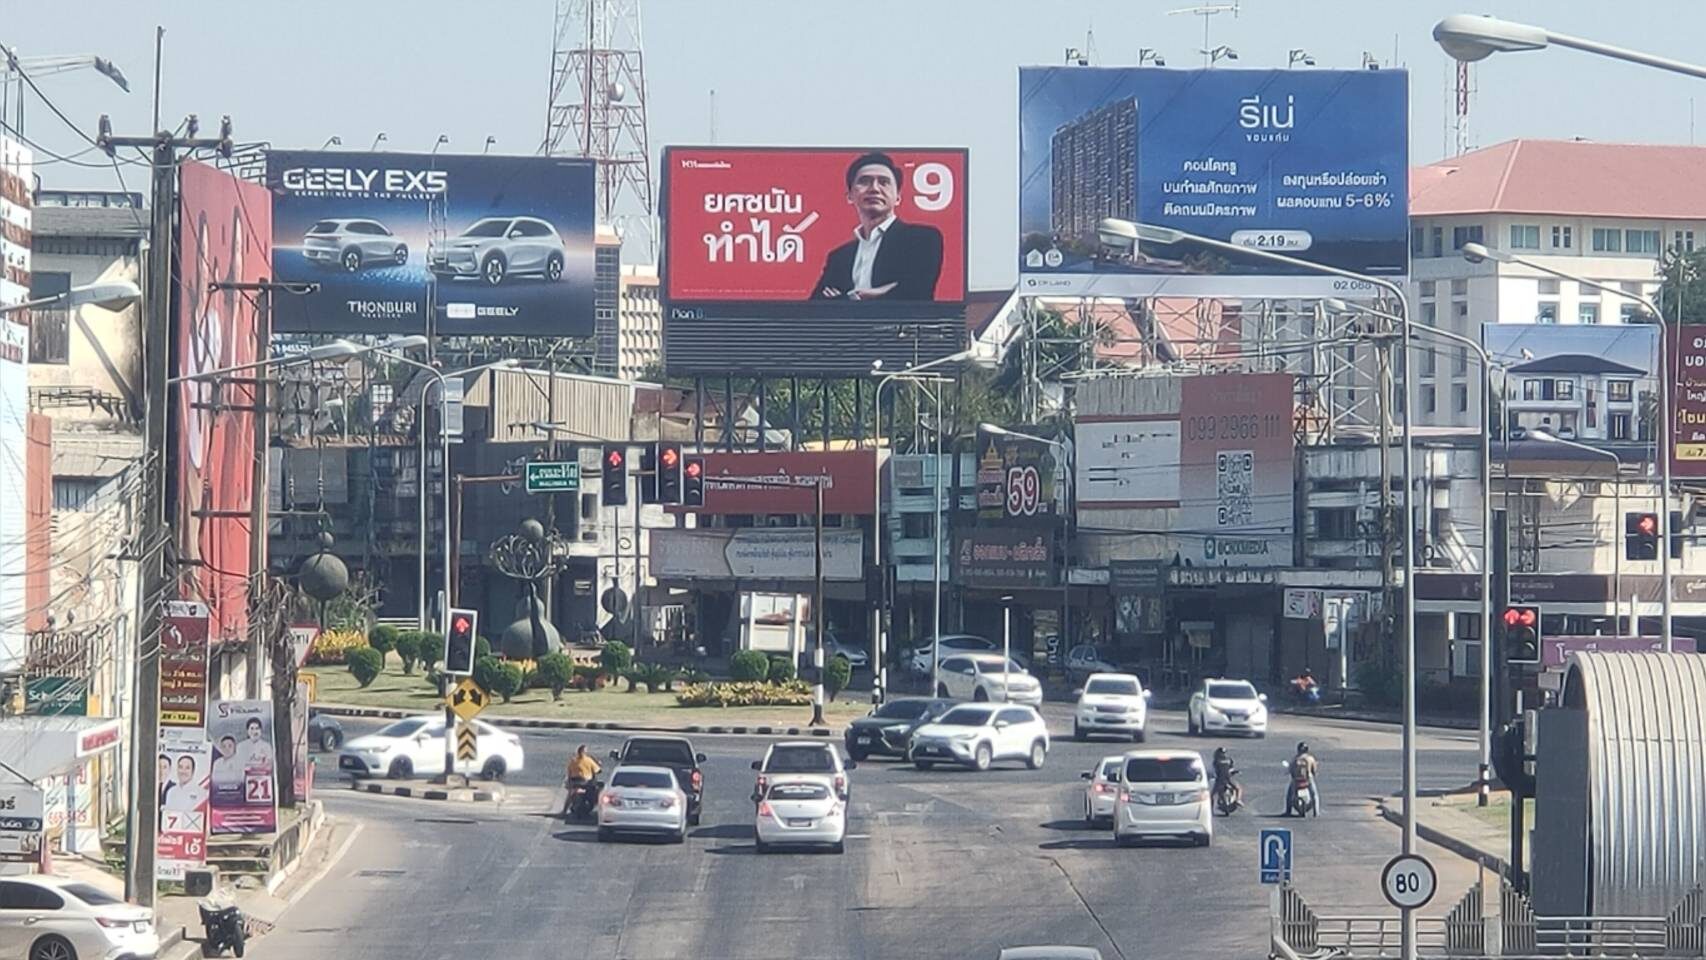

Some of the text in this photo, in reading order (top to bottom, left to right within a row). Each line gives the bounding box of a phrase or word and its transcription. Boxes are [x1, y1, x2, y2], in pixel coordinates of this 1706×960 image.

[1183, 157, 1237, 176] คอนโดหรู
[283, 168, 448, 192] GEELY EX5
[912, 162, 954, 211] 9
[1283, 171, 1387, 190] ลงทุนหรือปล่อยเช่า
[704, 187, 802, 213] ยศชนัน
[1164, 202, 1256, 216] ติดถนนมิตรภาพ
[1277, 196, 1342, 208] ผลตอบแทน
[703, 211, 819, 263] ทำได้
[1257, 234, 1285, 247] 2.19
[1333, 281, 1348, 290] 02
[347, 301, 416, 314] THONBURI
[477, 306, 519, 316] GEELY
[1188, 415, 1216, 440] 099
[1264, 413, 1280, 438] 111
[1007, 466, 1040, 516] 59
[248, 779, 271, 800] 21
[167, 816, 178, 829] 7
[1396, 872, 1420, 894] 80
